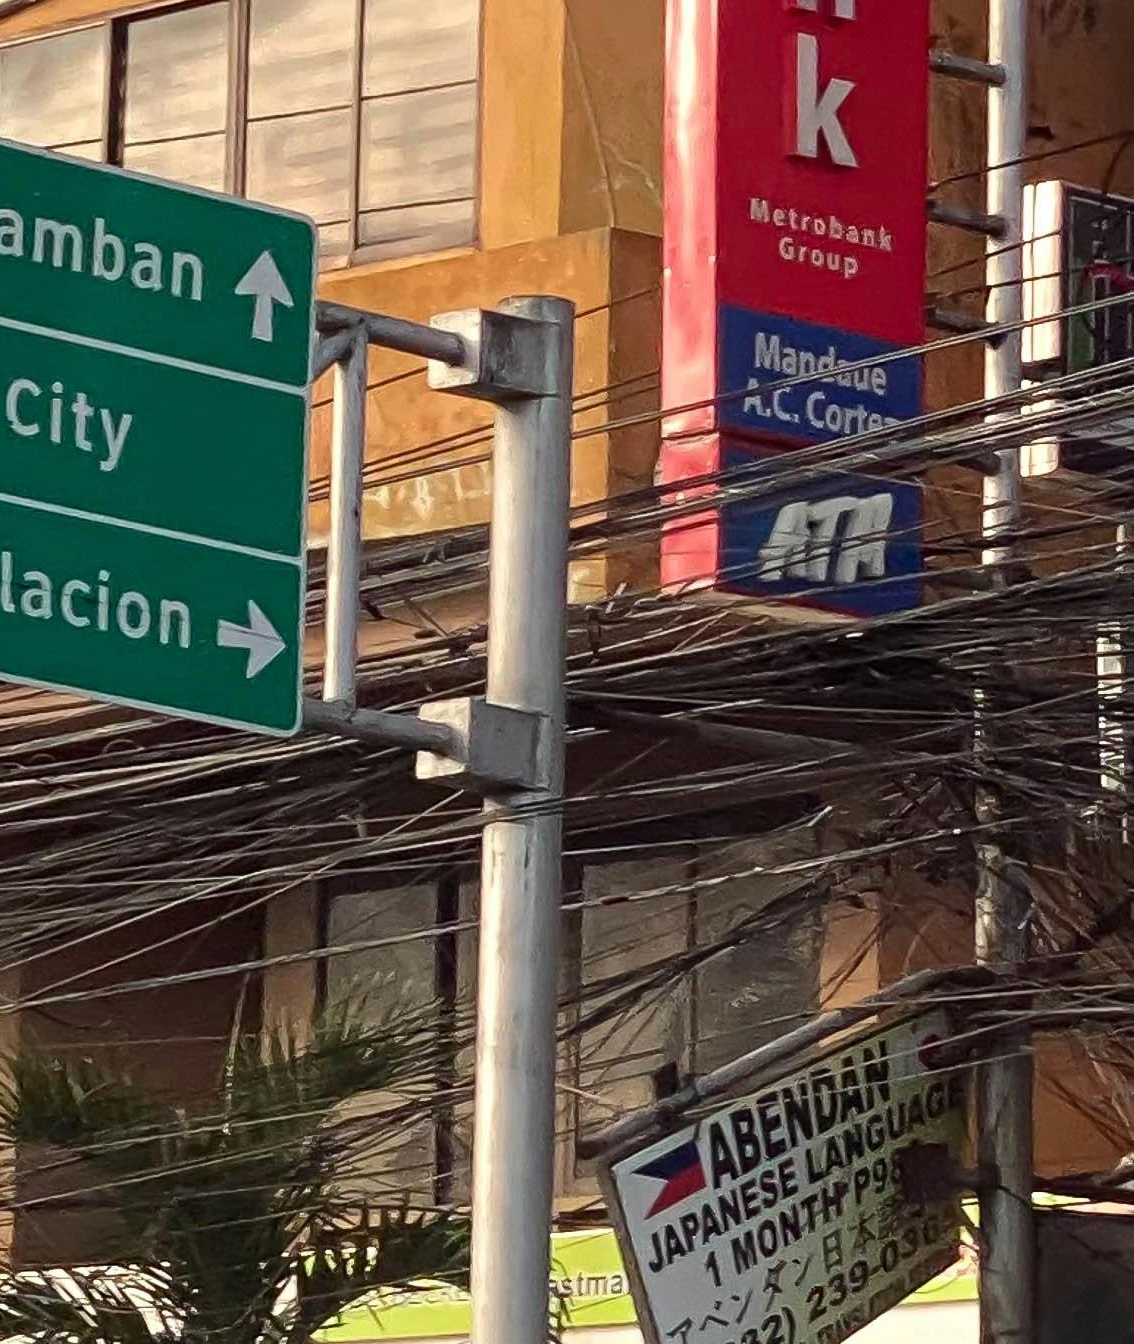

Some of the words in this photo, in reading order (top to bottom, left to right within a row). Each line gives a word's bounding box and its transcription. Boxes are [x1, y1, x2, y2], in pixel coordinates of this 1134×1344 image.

[748, 197, 894, 253] Metrobank
[778, 236, 860, 280] Group
[742, 376, 801, 424] A.C.
[754, 331, 888, 397] Mandaue
[5, 377, 133, 473] City
[708, 1039, 891, 1190] ABENDAN
[648, 1155, 799, 1273] JAPANESE
[805, 1077, 964, 1184] LANGUAGE
[704, 1250, 722, 1288] 1
[730, 1181, 849, 1275] MONTH
